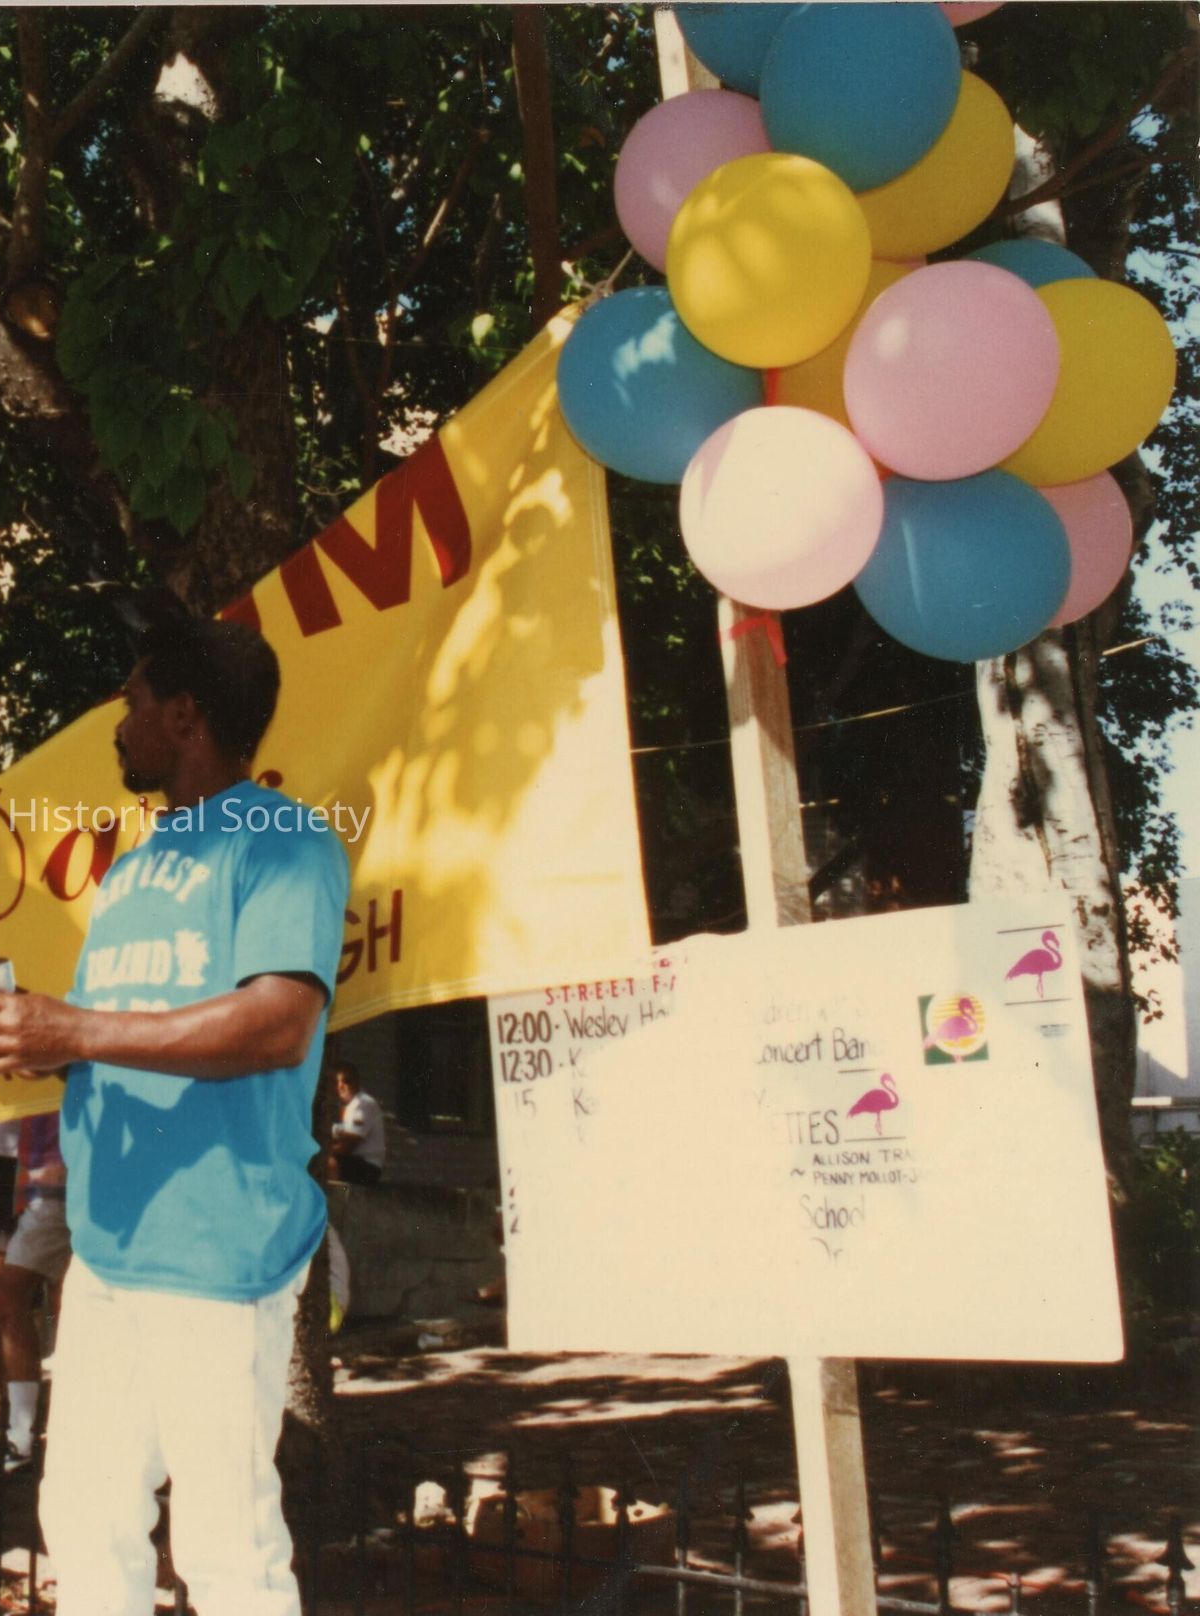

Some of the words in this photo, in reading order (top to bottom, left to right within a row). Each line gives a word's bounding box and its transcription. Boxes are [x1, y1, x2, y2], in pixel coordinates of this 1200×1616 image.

[497, 1010, 553, 1045] 12:00
[756, 1031, 823, 1065] oncert
[812, 1151, 871, 1167] ALLISON
[813, 1169, 854, 1186] PENNY
